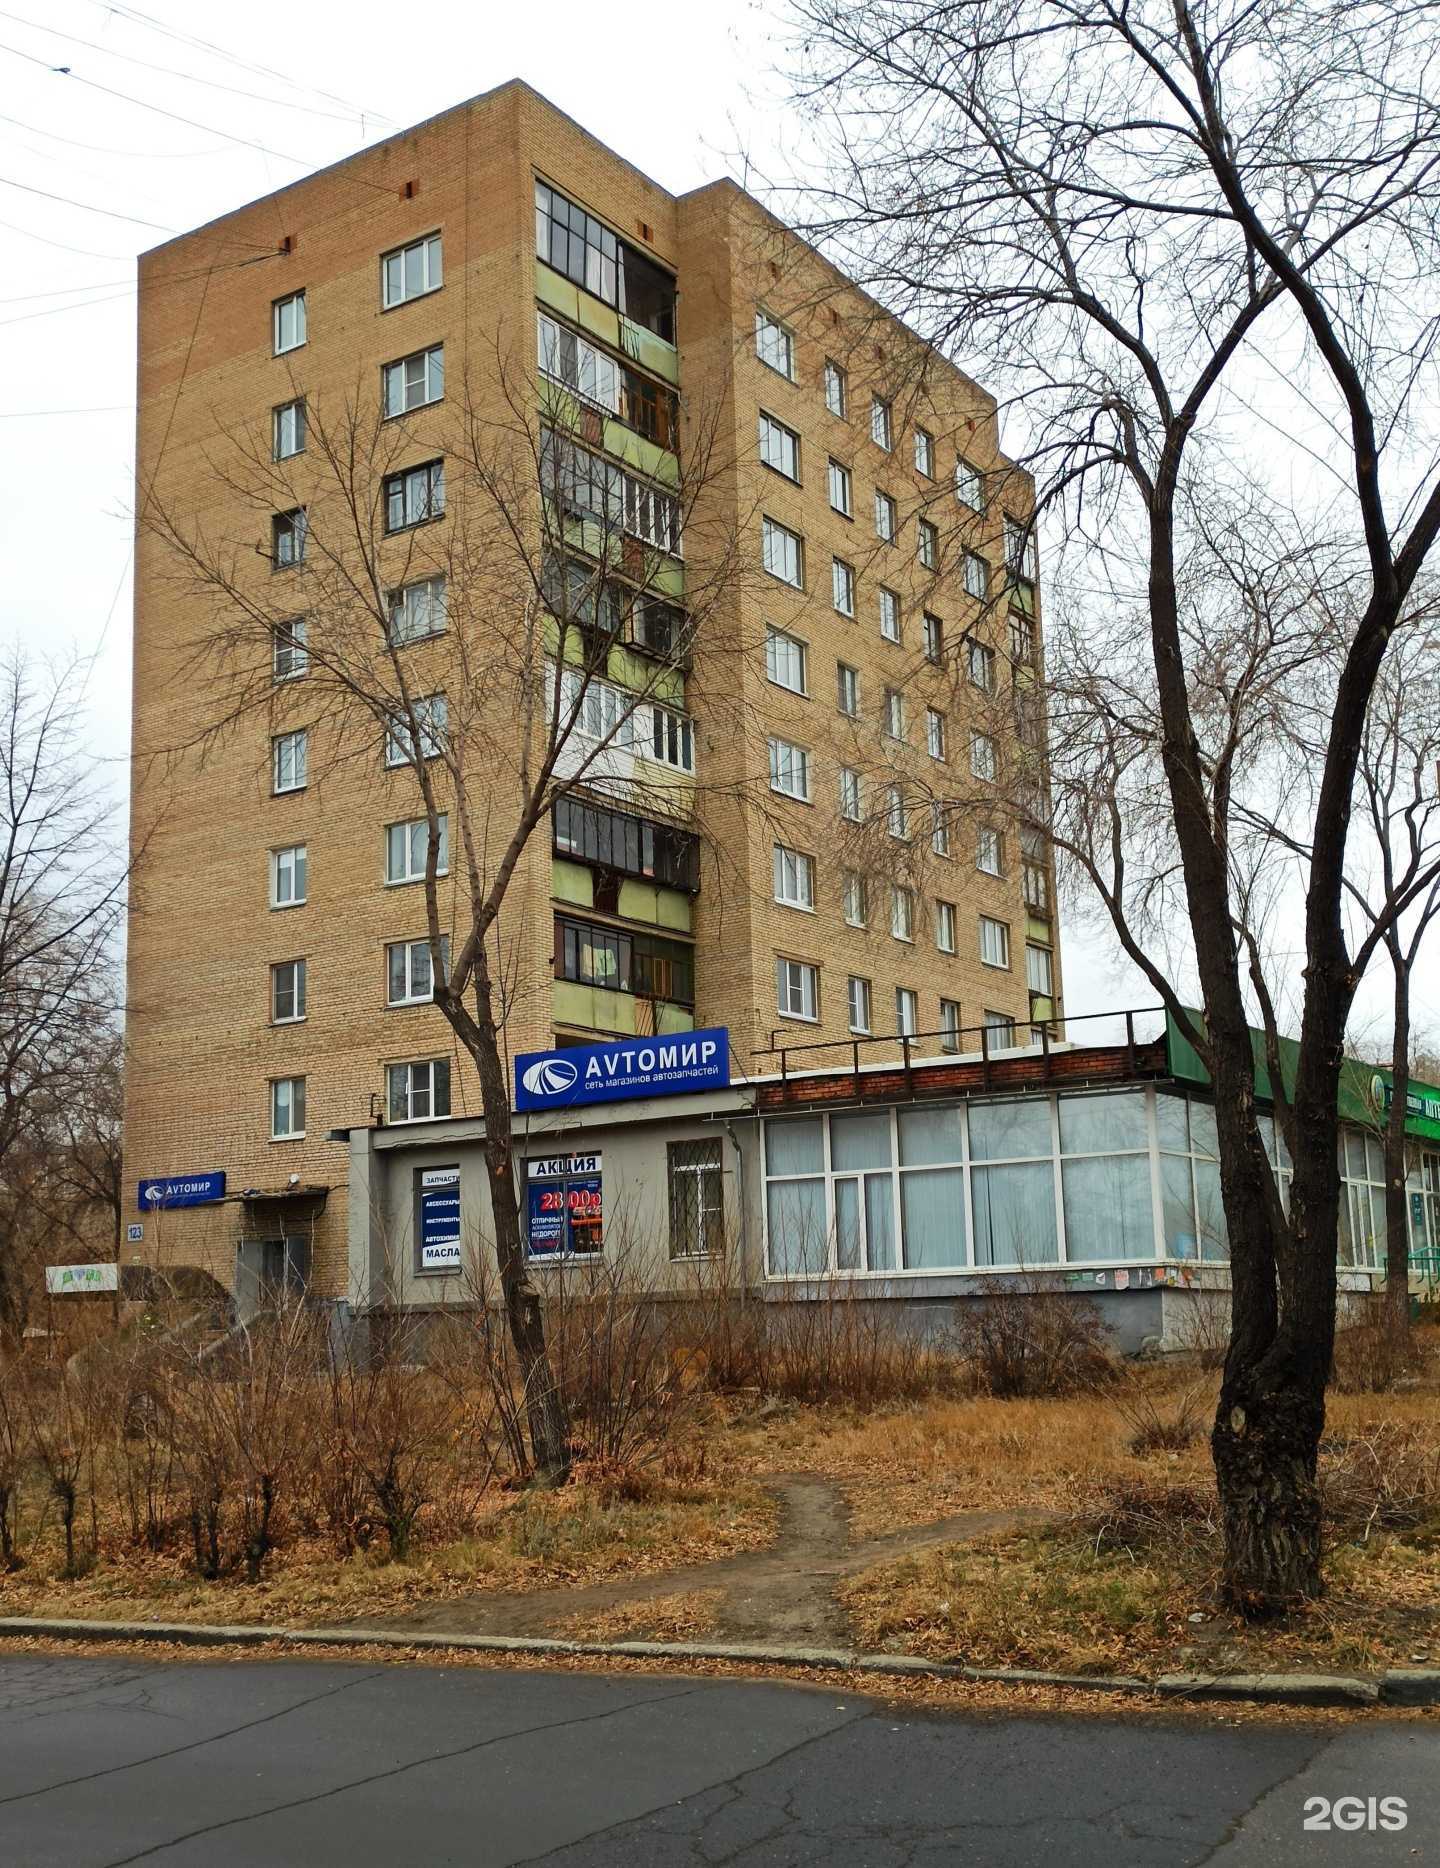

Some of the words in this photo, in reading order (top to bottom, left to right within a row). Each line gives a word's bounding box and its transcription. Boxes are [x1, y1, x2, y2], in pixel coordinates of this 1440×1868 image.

[585, 1080, 604, 1089] сеть
[605, 1074, 651, 1088] магазинов
[652, 1064, 720, 1083] автозапчастей
[536, 1157, 597, 1175] АКЦИЯ
[426, 1247, 460, 1258] МАСЛА
